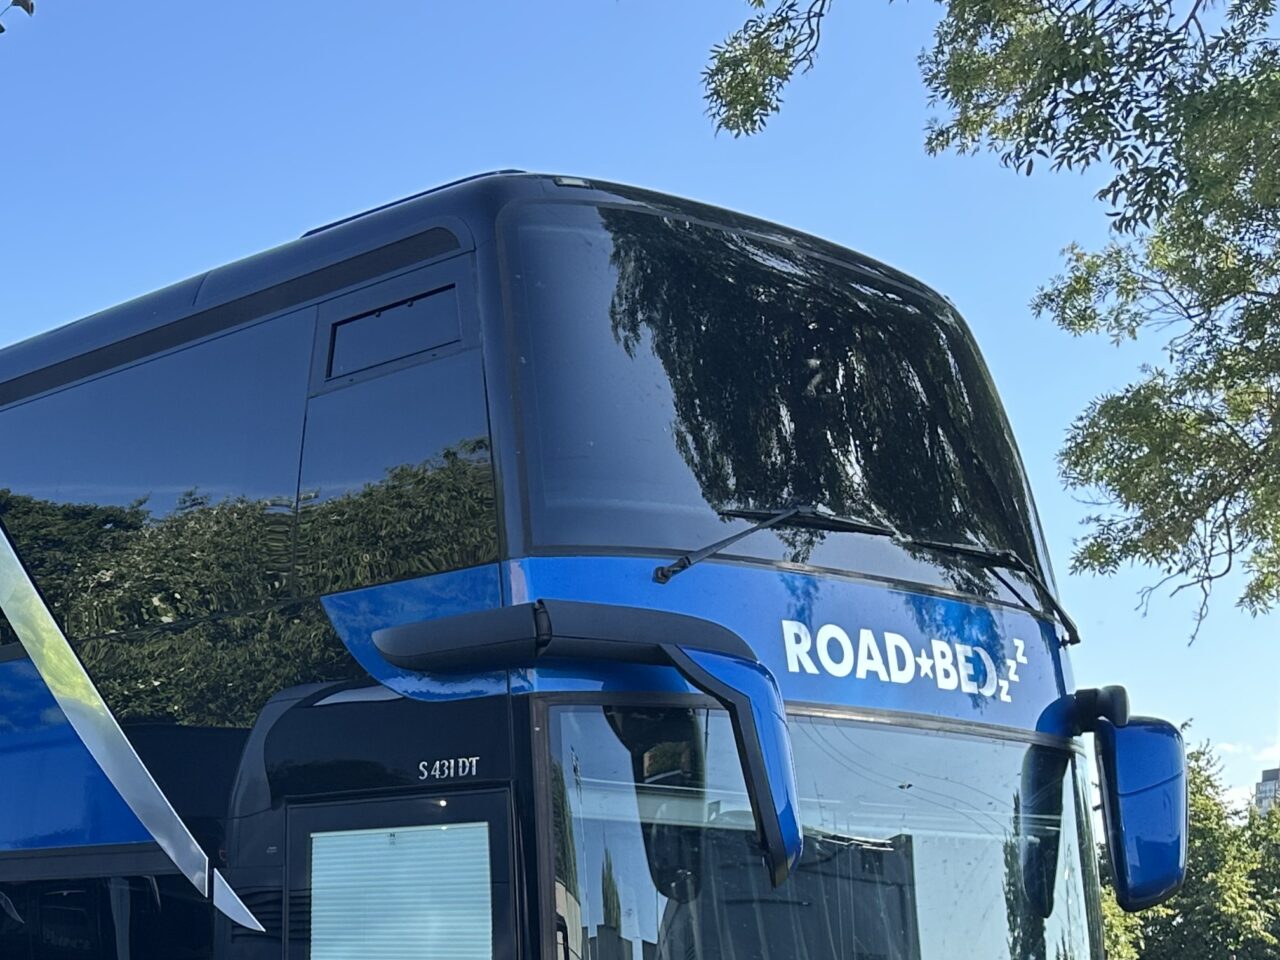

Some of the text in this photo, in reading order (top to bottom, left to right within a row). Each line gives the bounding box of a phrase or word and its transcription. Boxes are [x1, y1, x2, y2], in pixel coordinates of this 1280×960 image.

[782, 620, 915, 684] ROAD
[418, 757, 480, 780] S 431 DT
